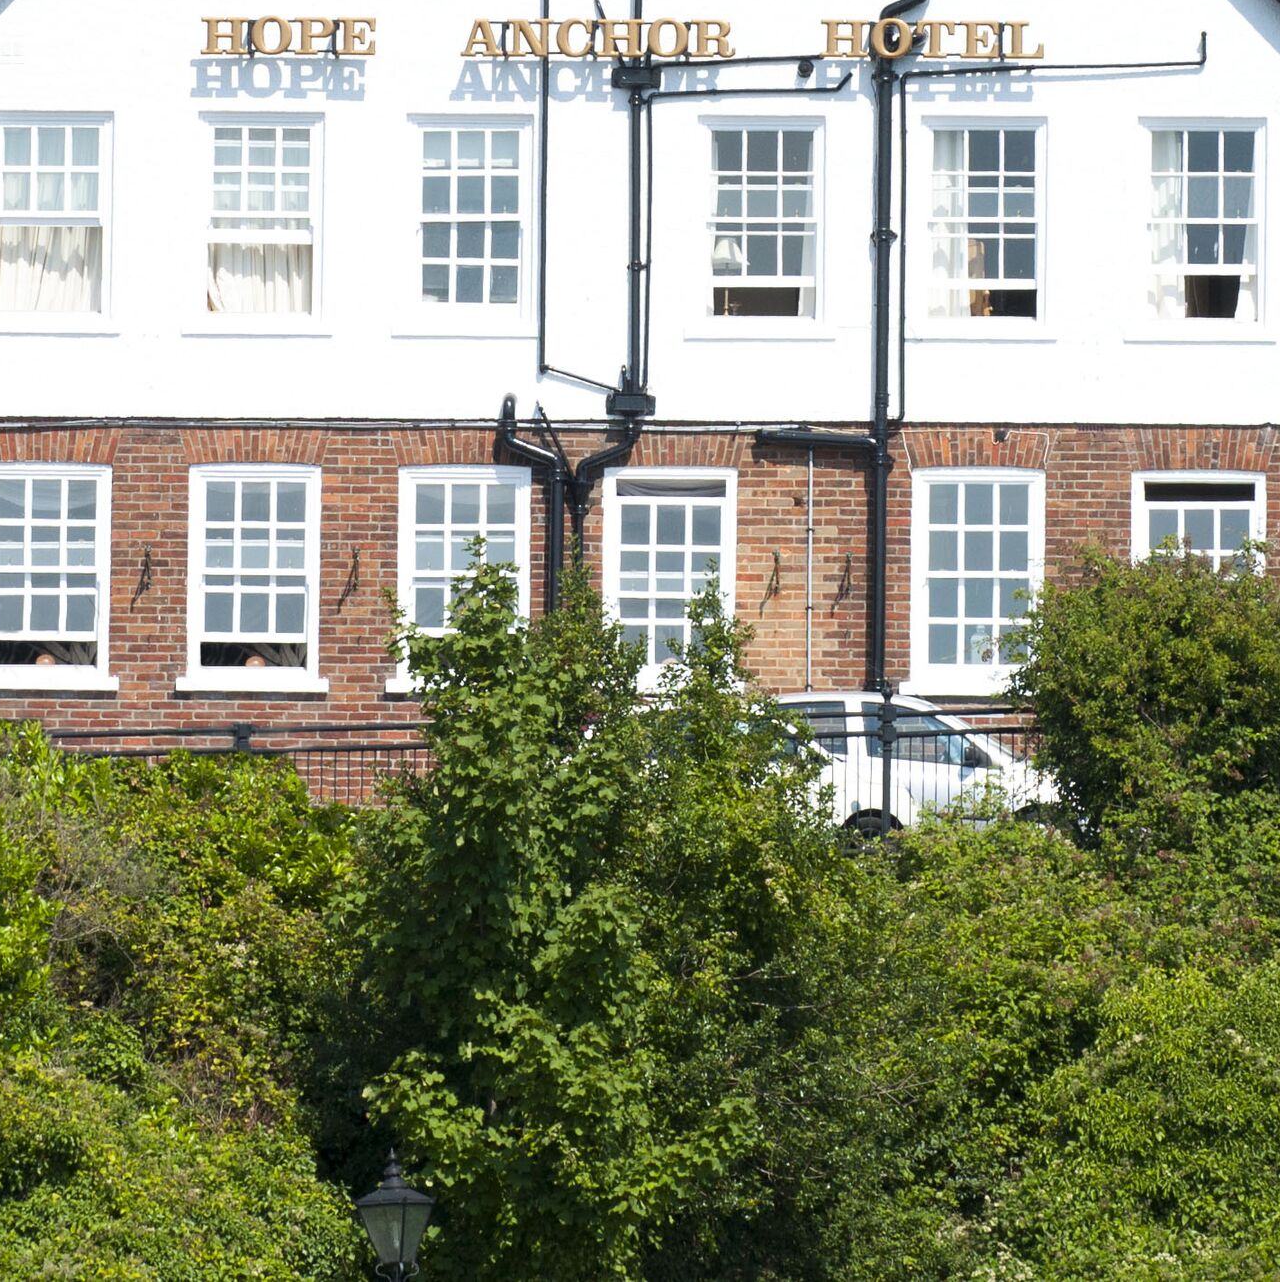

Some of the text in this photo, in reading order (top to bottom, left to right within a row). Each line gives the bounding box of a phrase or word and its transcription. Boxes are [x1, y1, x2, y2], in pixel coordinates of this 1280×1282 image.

[200, 15, 1045, 59] HOPE ANCHOR HOTEL
